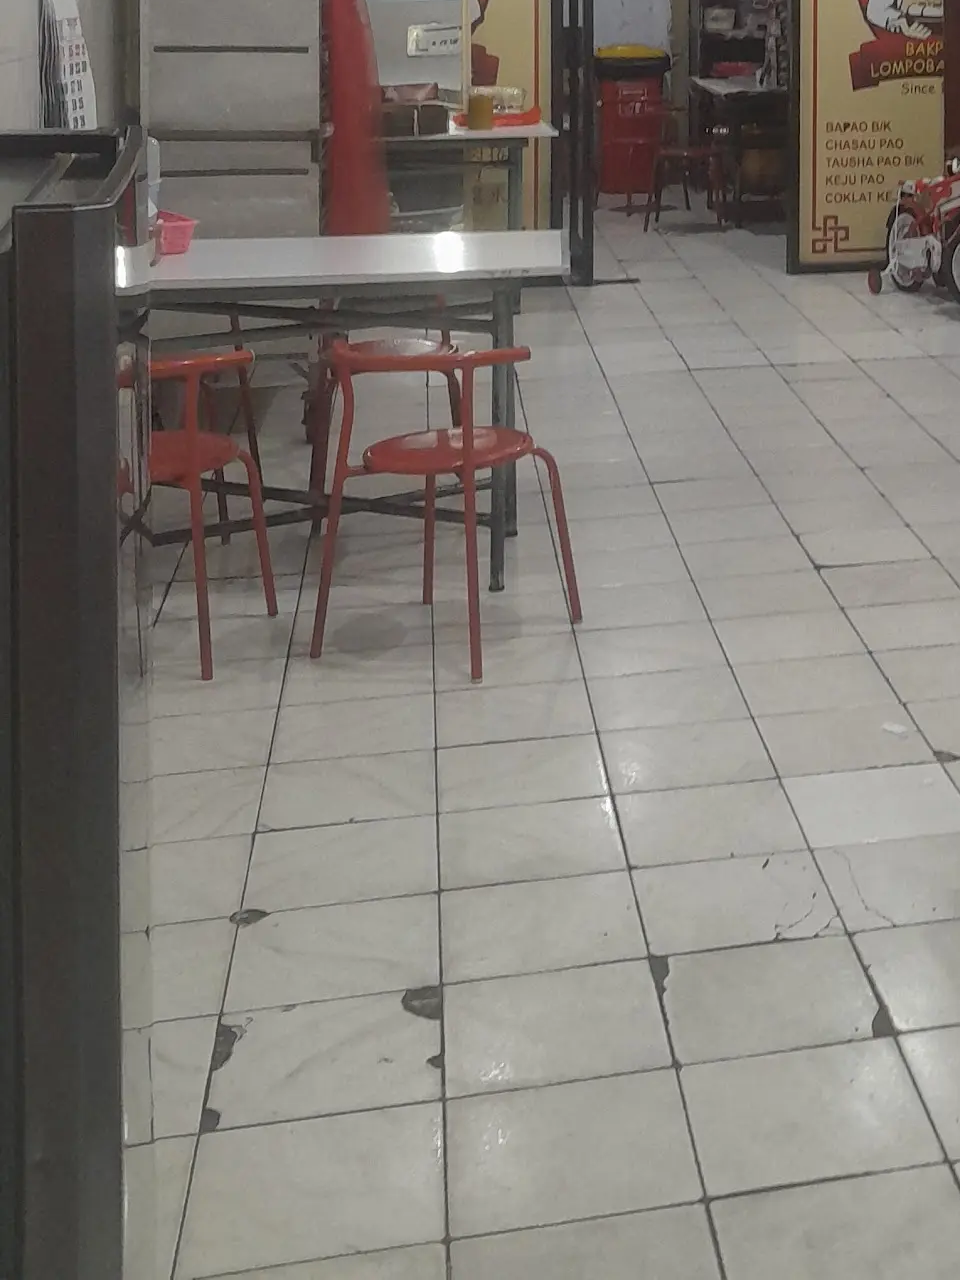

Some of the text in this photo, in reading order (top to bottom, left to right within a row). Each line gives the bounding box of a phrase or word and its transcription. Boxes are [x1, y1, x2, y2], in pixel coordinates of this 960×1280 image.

[901, 82, 936, 95] Since
[825, 121, 868, 133] BAPAO
[879, 138, 904, 150] PAO
[825, 157, 874, 169] TAUSHA
[877, 156, 901, 168] PAO
[825, 173, 885, 186] KEJU PAO
[825, 192, 872, 204] COKLAT
